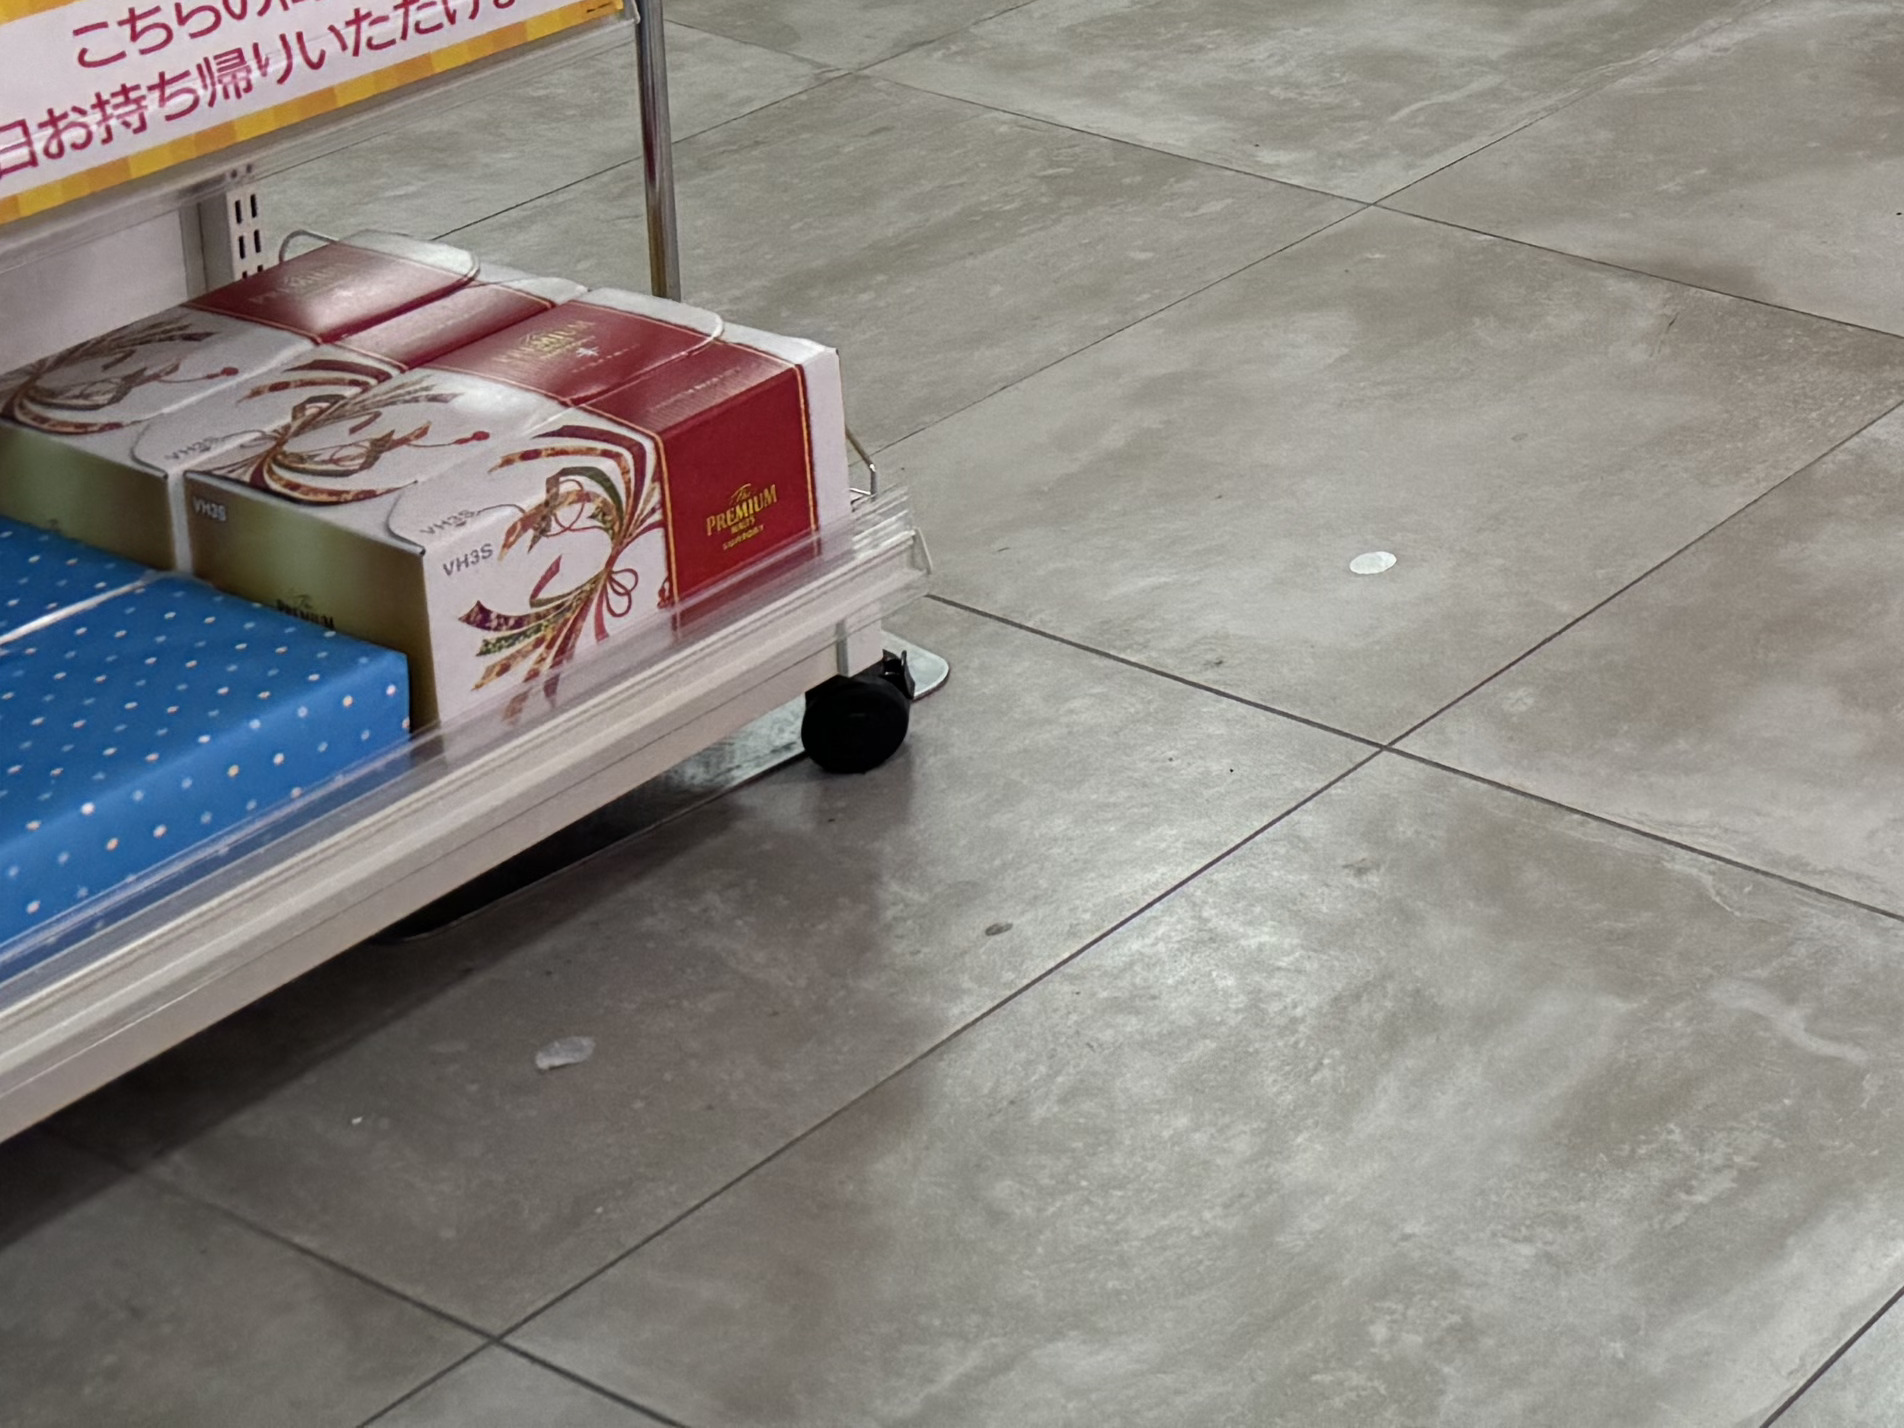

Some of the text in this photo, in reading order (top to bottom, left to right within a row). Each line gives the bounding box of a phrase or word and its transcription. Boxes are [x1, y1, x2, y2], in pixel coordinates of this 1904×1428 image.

[192, 497, 227, 522] VH3S
[420, 508, 475, 536] VH3S
[706, 484, 778, 536] PREMIUM
[442, 542, 494, 577] VH3S
